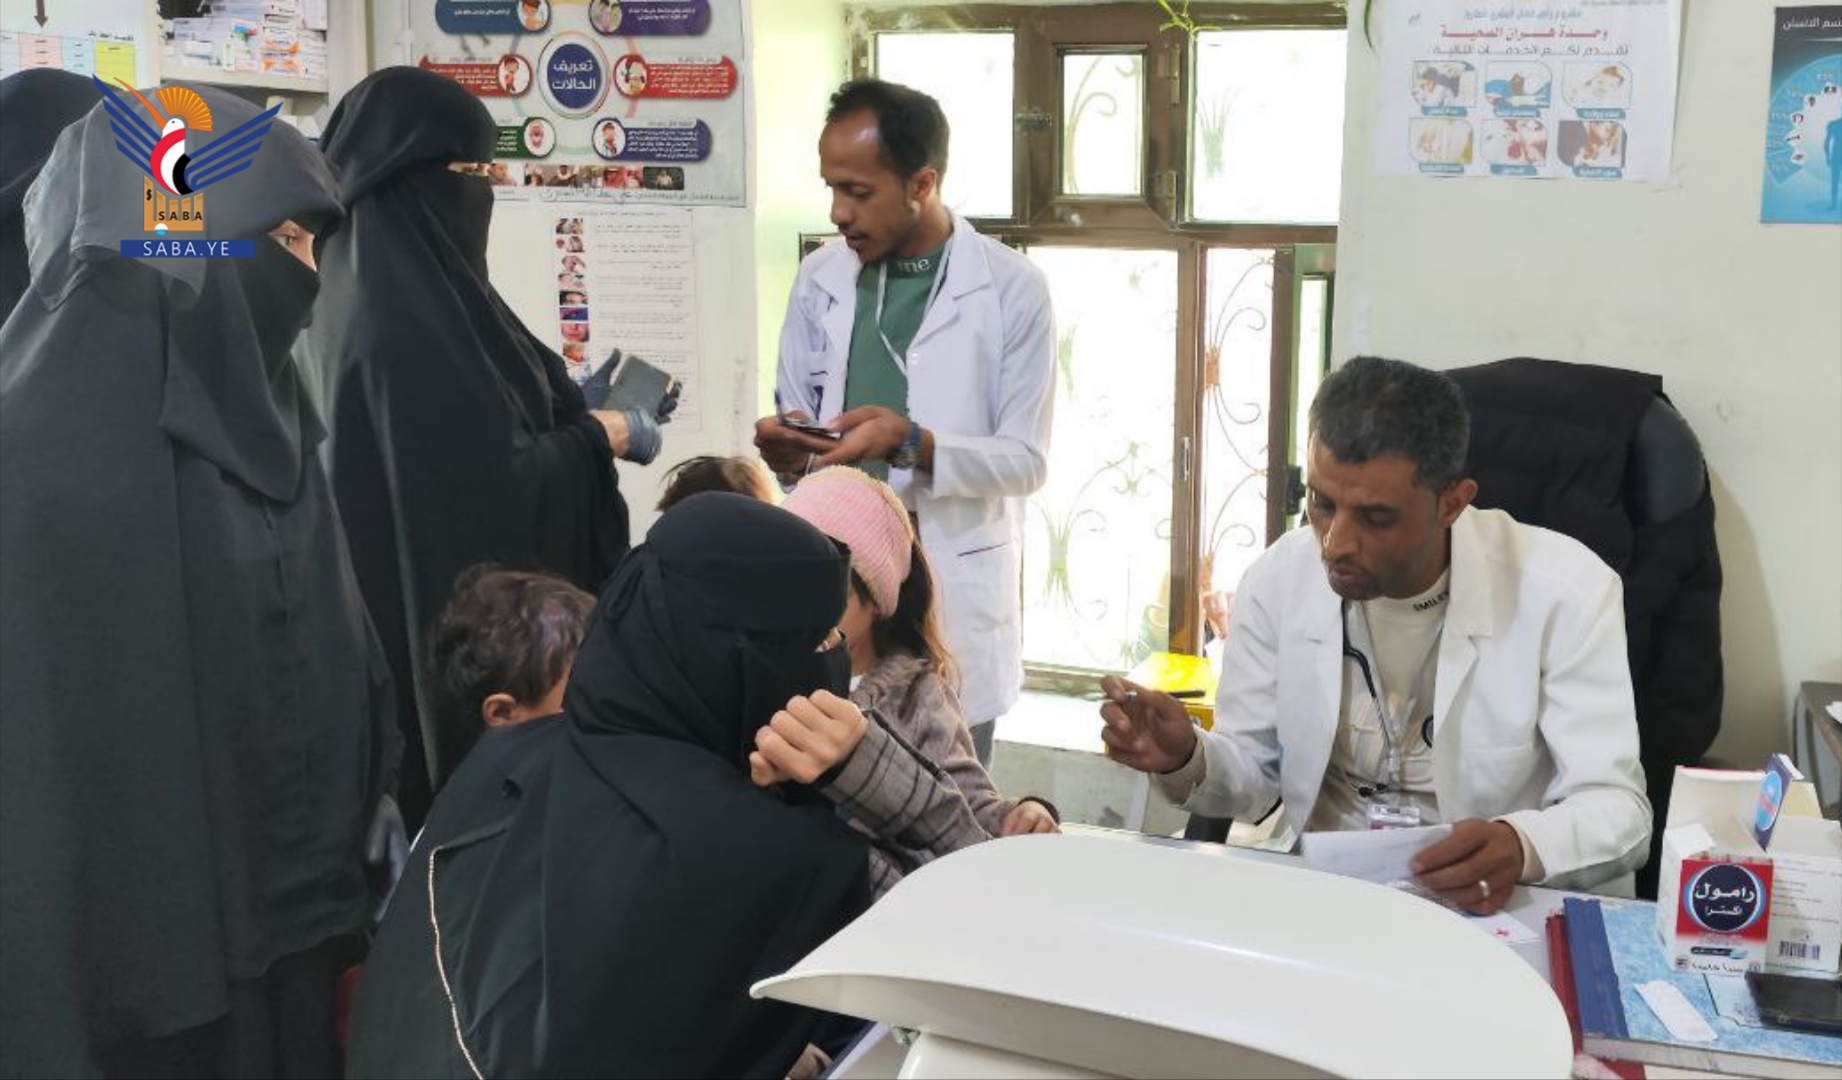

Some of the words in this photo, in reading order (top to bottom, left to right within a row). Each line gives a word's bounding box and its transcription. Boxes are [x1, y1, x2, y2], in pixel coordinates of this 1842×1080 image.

[1478, 44, 1537, 56] الخدمات
[1540, 44, 1580, 57] لكم
[553, 60, 593, 74] تعريف
[552, 77, 596, 90] الحالات
[1694, 882, 1756, 903] رامول
